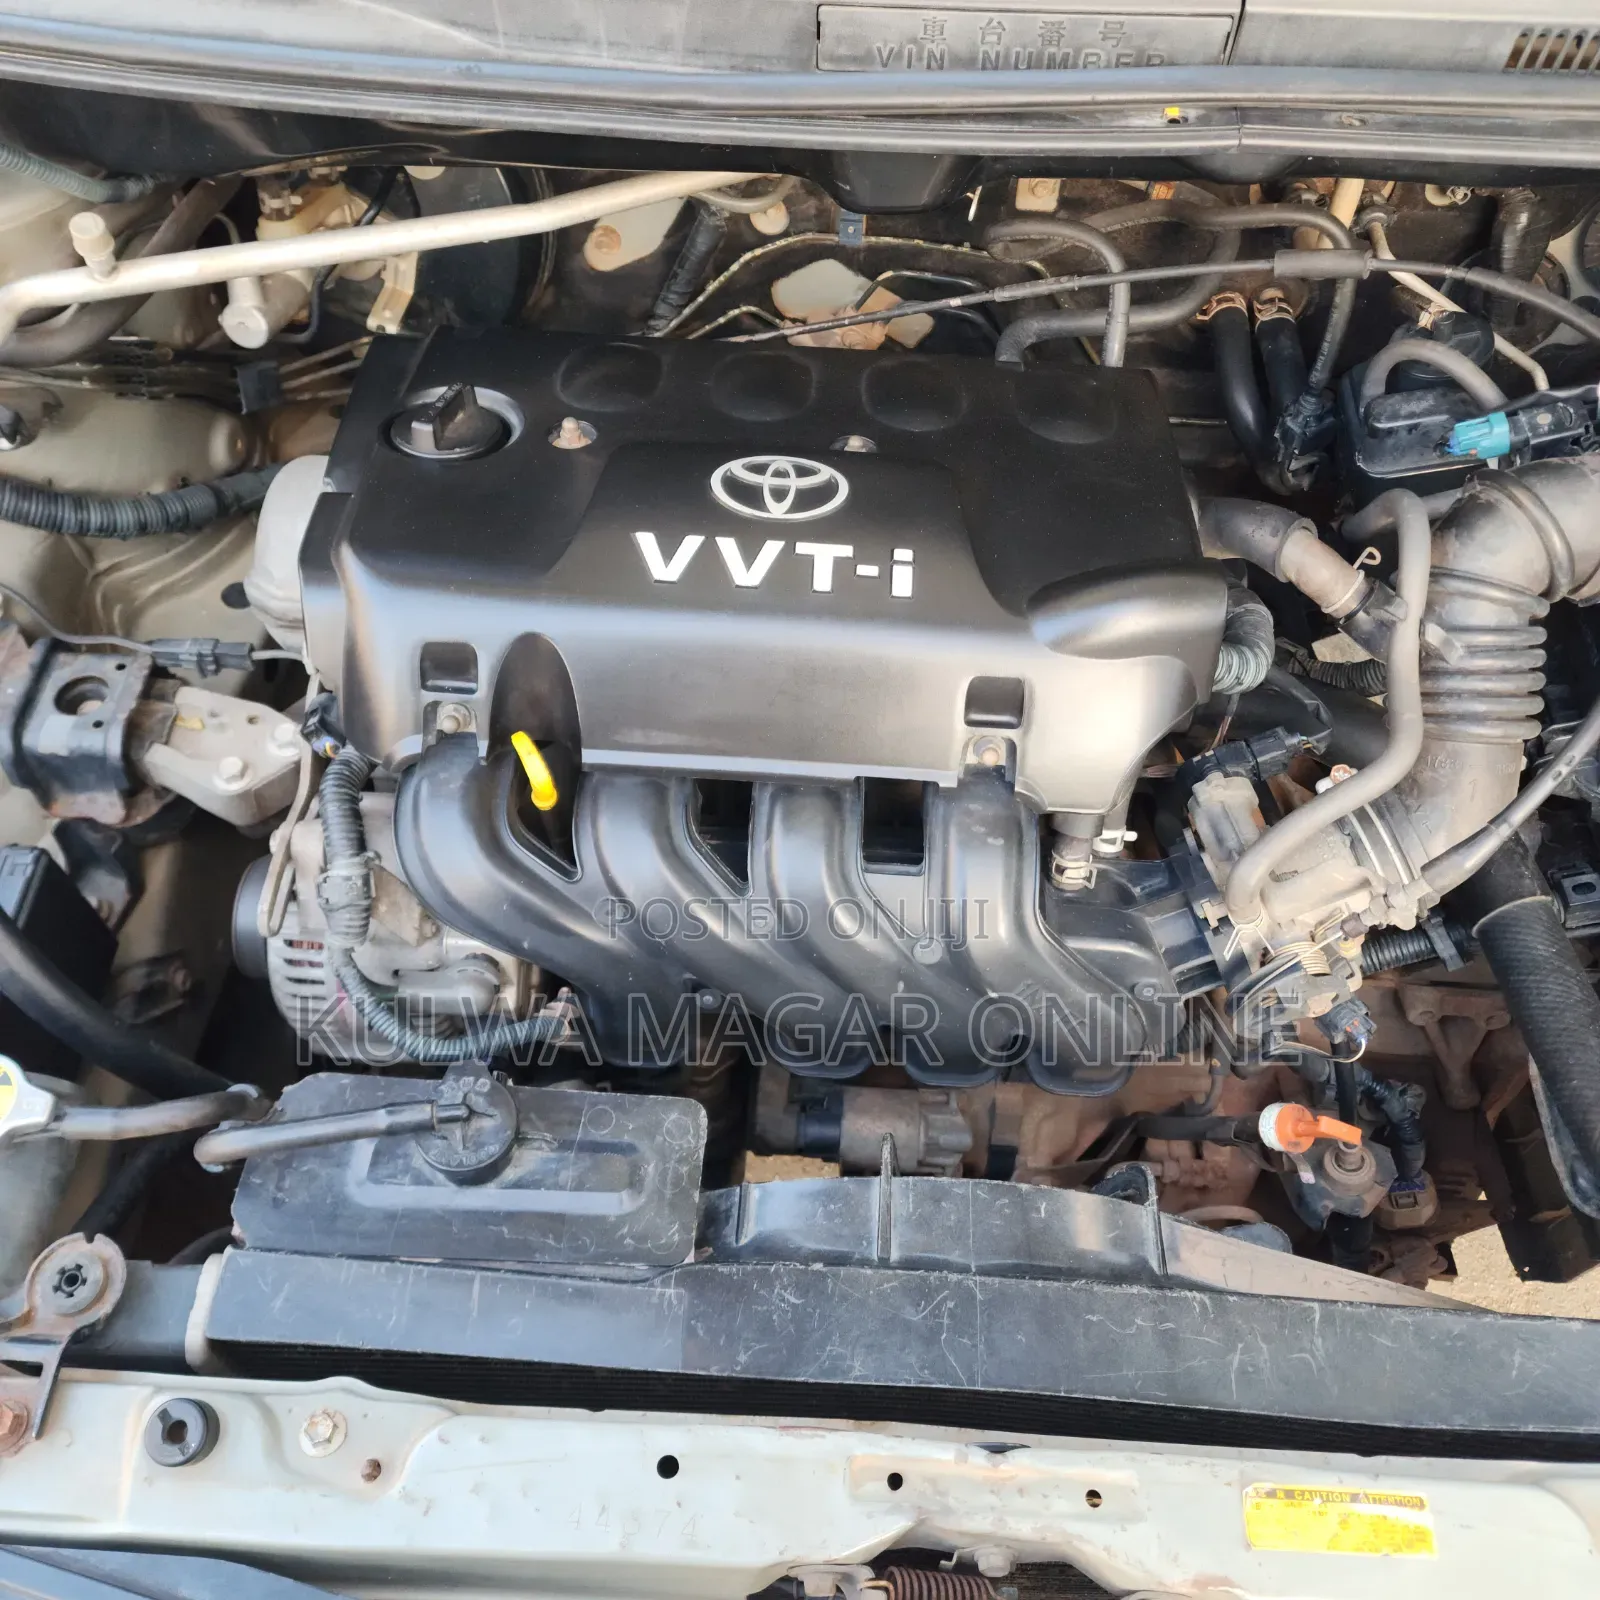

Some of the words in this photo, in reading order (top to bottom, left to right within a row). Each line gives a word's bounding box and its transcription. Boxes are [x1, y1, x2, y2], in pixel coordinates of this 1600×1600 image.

[919, 16, 1128, 49] 車台番号
[876, 44, 946, 70] VIN
[633, 531, 915, 599] VVT-i
[1294, 1490, 1351, 1503] CAUTION
[1360, 1494, 1422, 1507] ATTENTION
